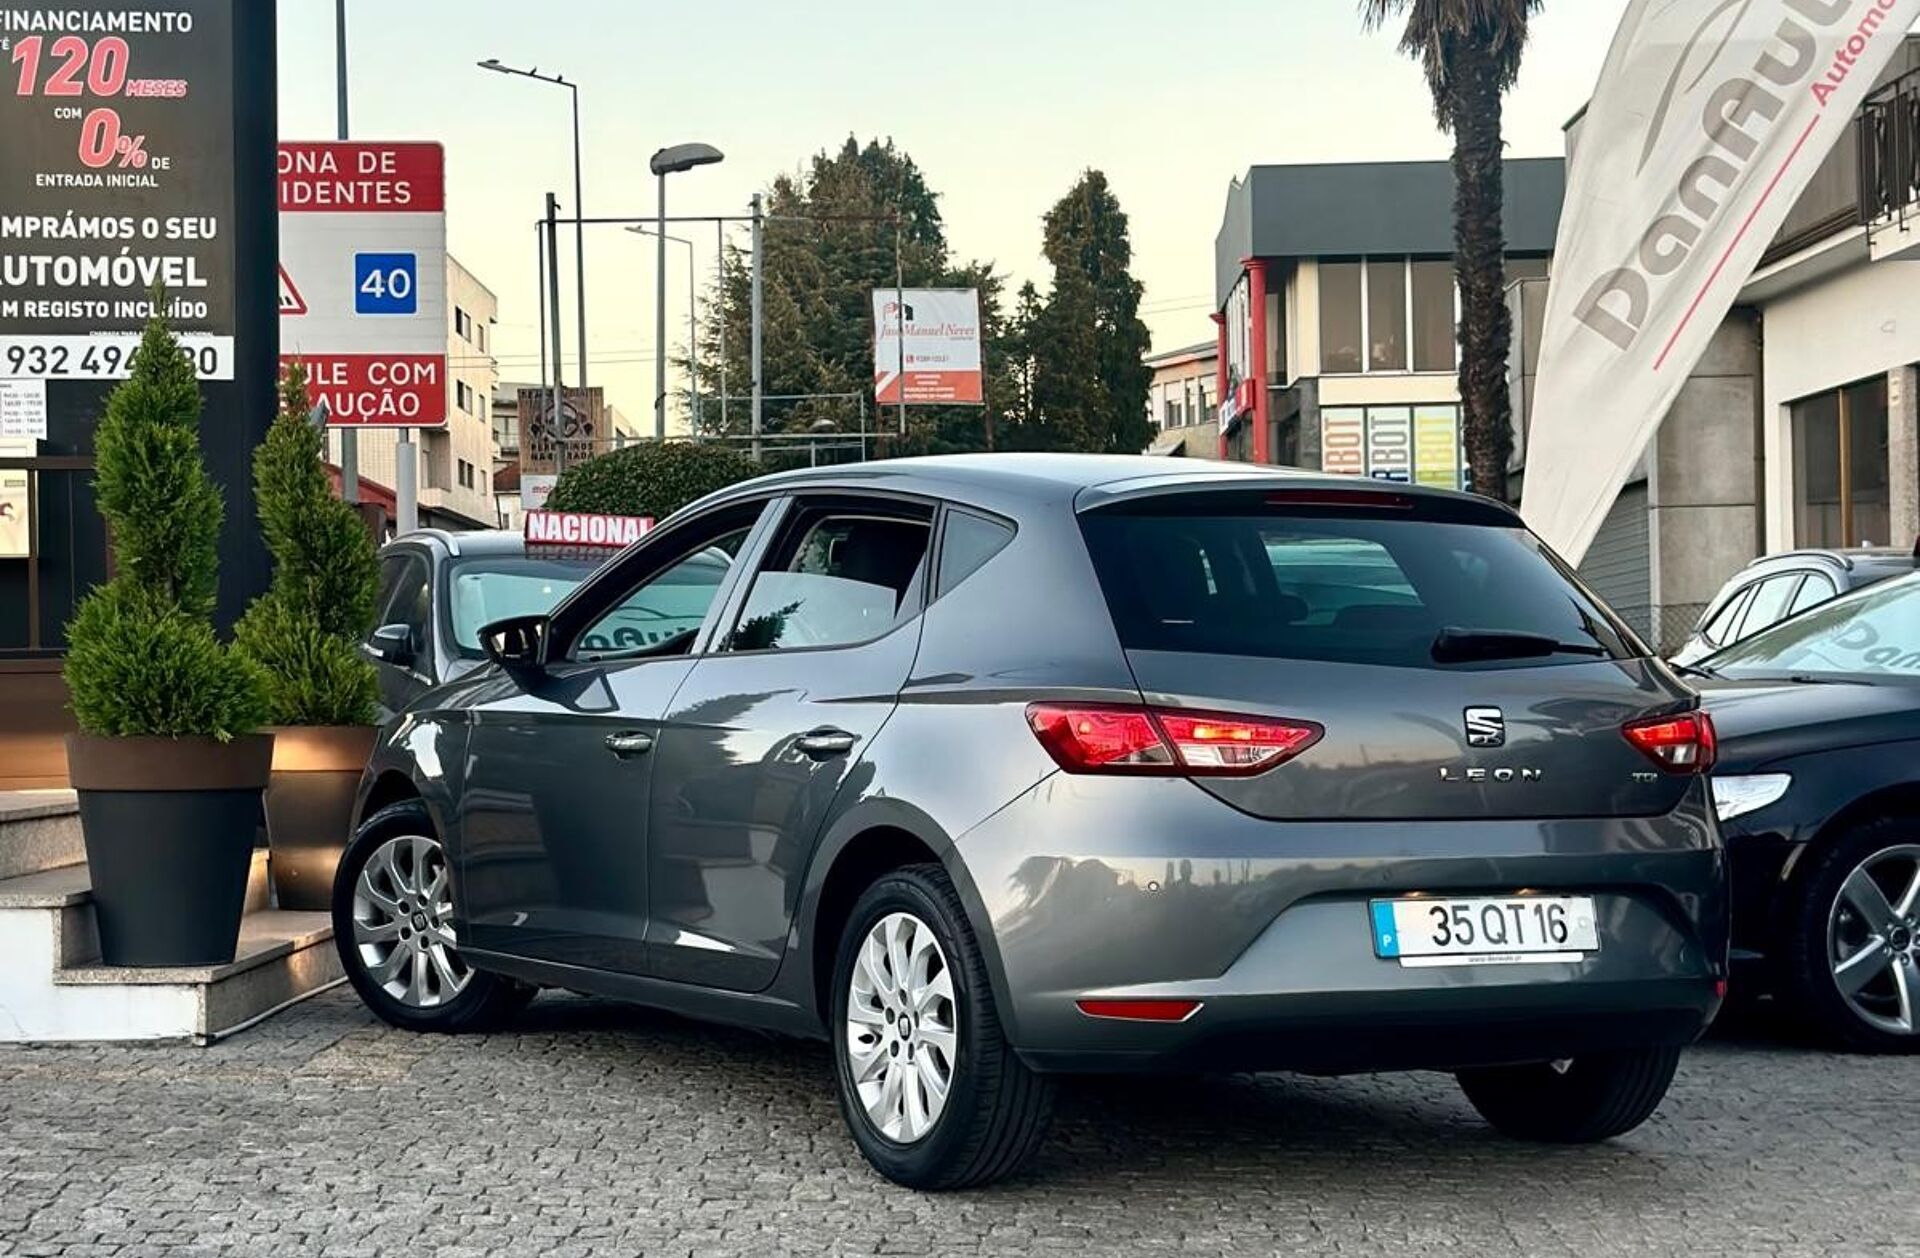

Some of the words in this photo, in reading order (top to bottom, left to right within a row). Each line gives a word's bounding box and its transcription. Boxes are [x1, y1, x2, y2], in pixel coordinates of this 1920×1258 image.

[12, 35, 130, 97] 120
[126, 79, 187, 98] MESES
[54, 107, 83, 119] COM
[151, 157, 171, 170] DE
[358, 151, 397, 174] DE
[36, 173, 104, 188] ENTRADA
[106, 174, 160, 188] INICIAL
[141, 217, 160, 240] O
[165, 217, 217, 240] SEU
[0, 246, 208, 288] UTOMÓVEL
[360, 268, 412, 299] 40
[24, 300, 110, 319] REGISTO
[7, 345, 69, 375] 932
[367, 361, 436, 386] COM
[1439, 767, 1542, 783] LEON
